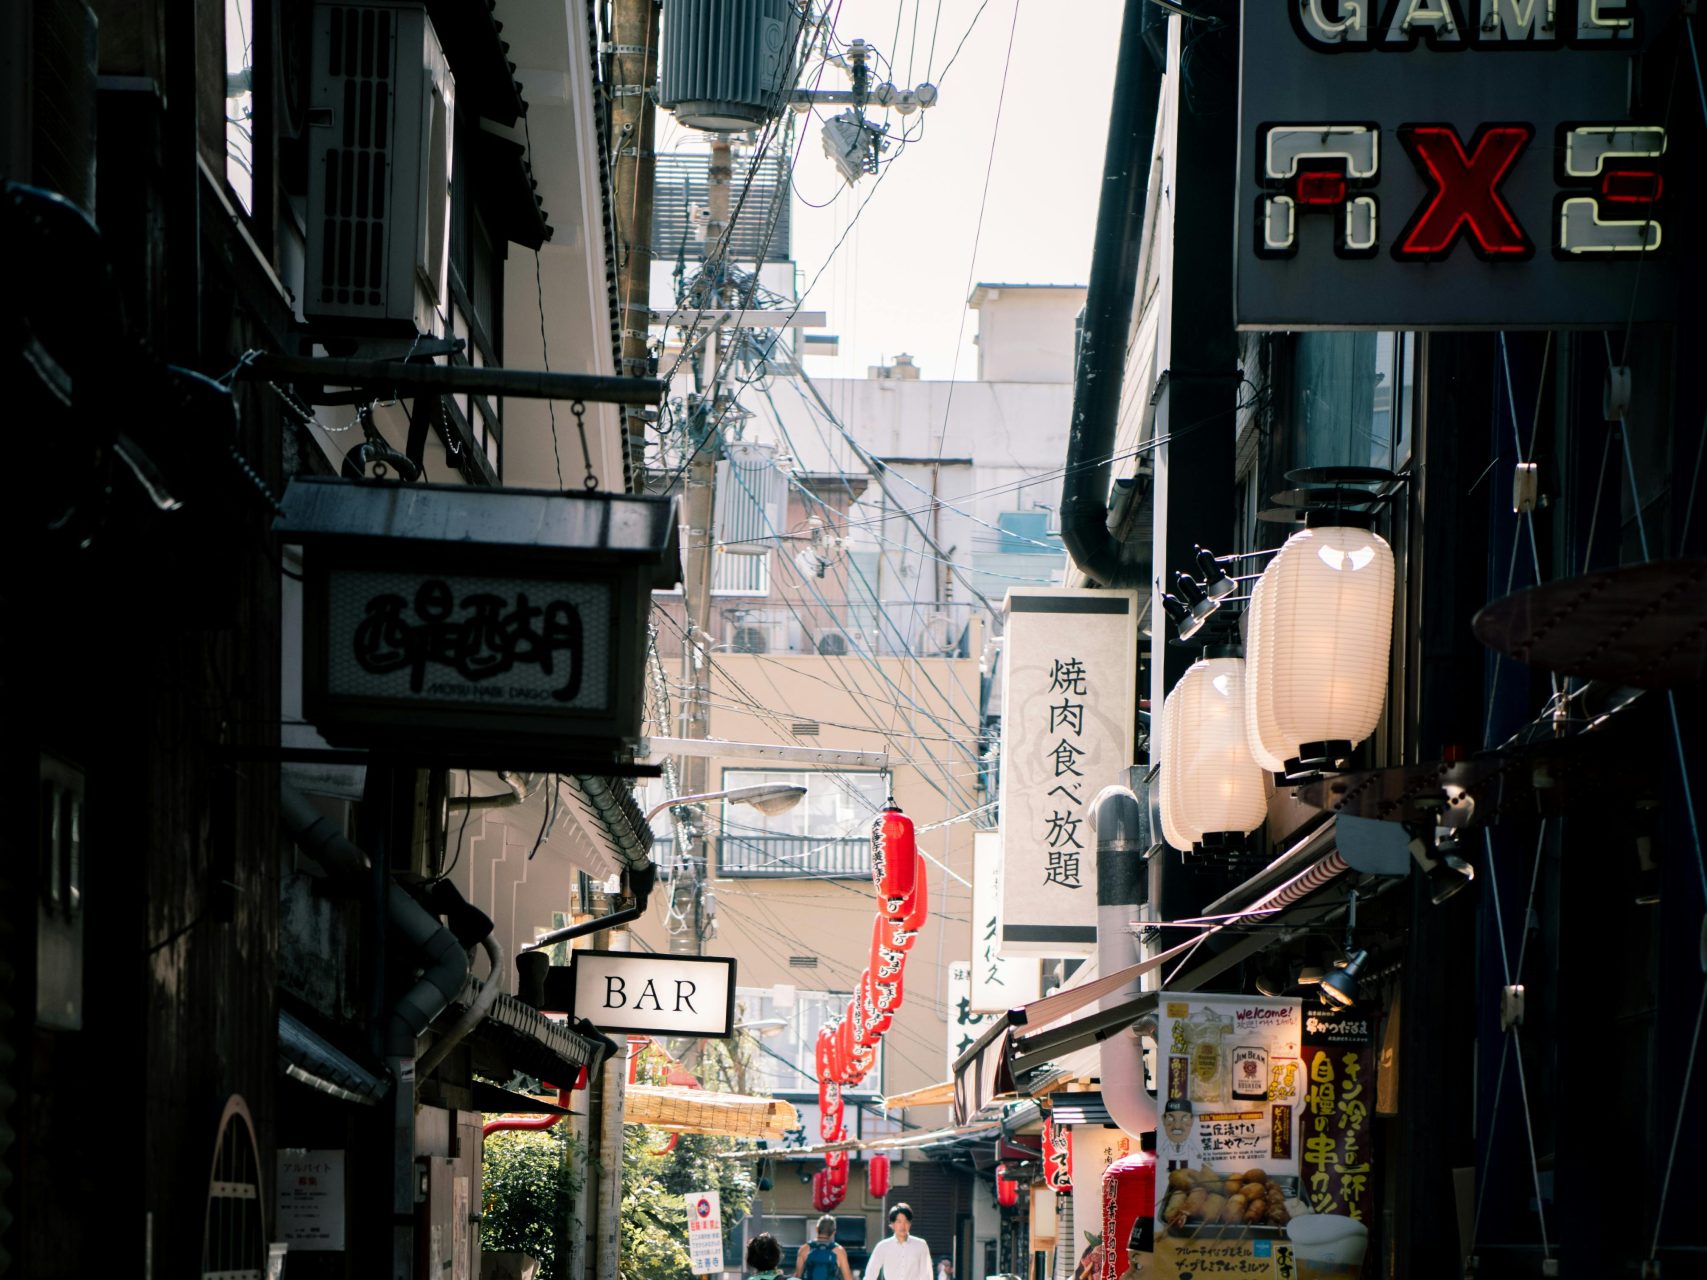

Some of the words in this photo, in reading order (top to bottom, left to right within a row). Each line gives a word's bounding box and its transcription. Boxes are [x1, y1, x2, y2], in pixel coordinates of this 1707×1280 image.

[1043, 656, 1087, 889] 焼肉食べ放題
[603, 975, 698, 1015] BAR
[1305, 1017, 1368, 1036] 串かつだるま
